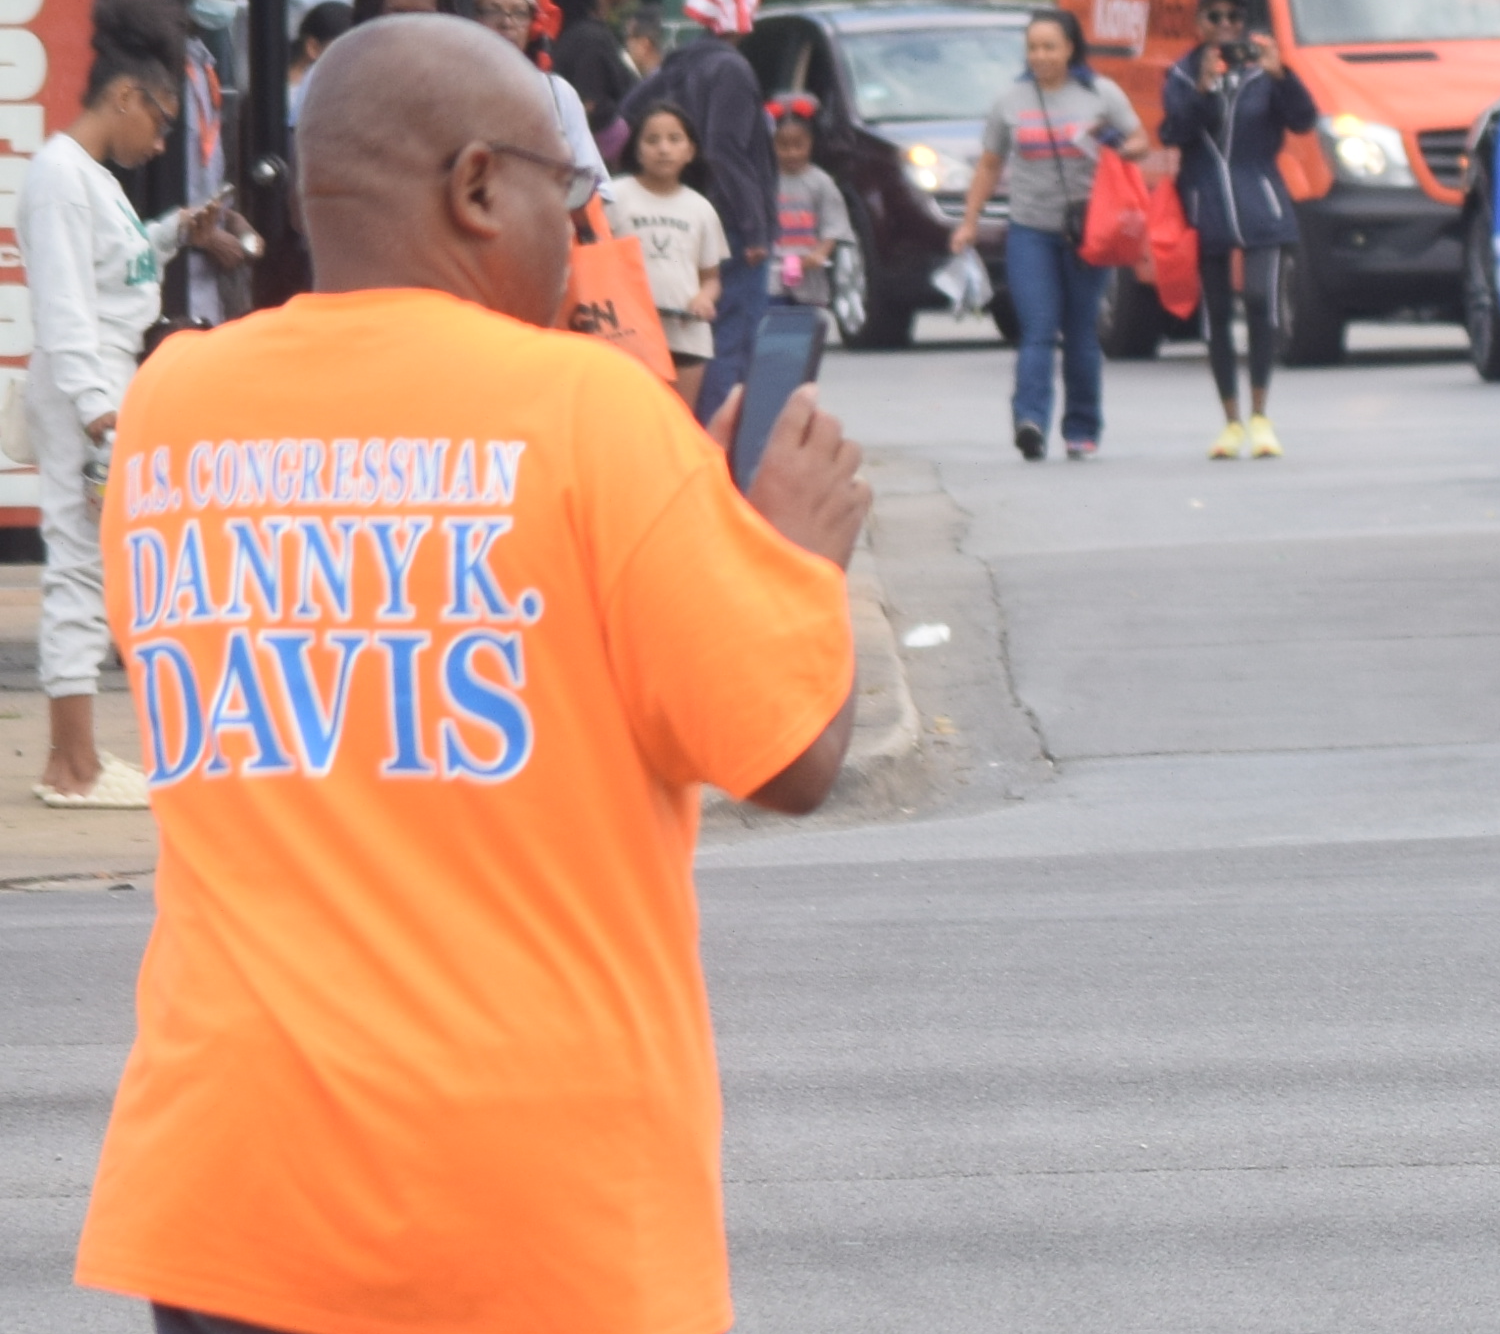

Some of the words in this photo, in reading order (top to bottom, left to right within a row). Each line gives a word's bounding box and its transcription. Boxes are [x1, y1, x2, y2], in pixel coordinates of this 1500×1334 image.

[188, 438, 526, 509] CONGRESSMAN
[127, 516, 432, 633] DANNY
[441, 516, 544, 624] K.
[133, 628, 534, 785] DAVIS
